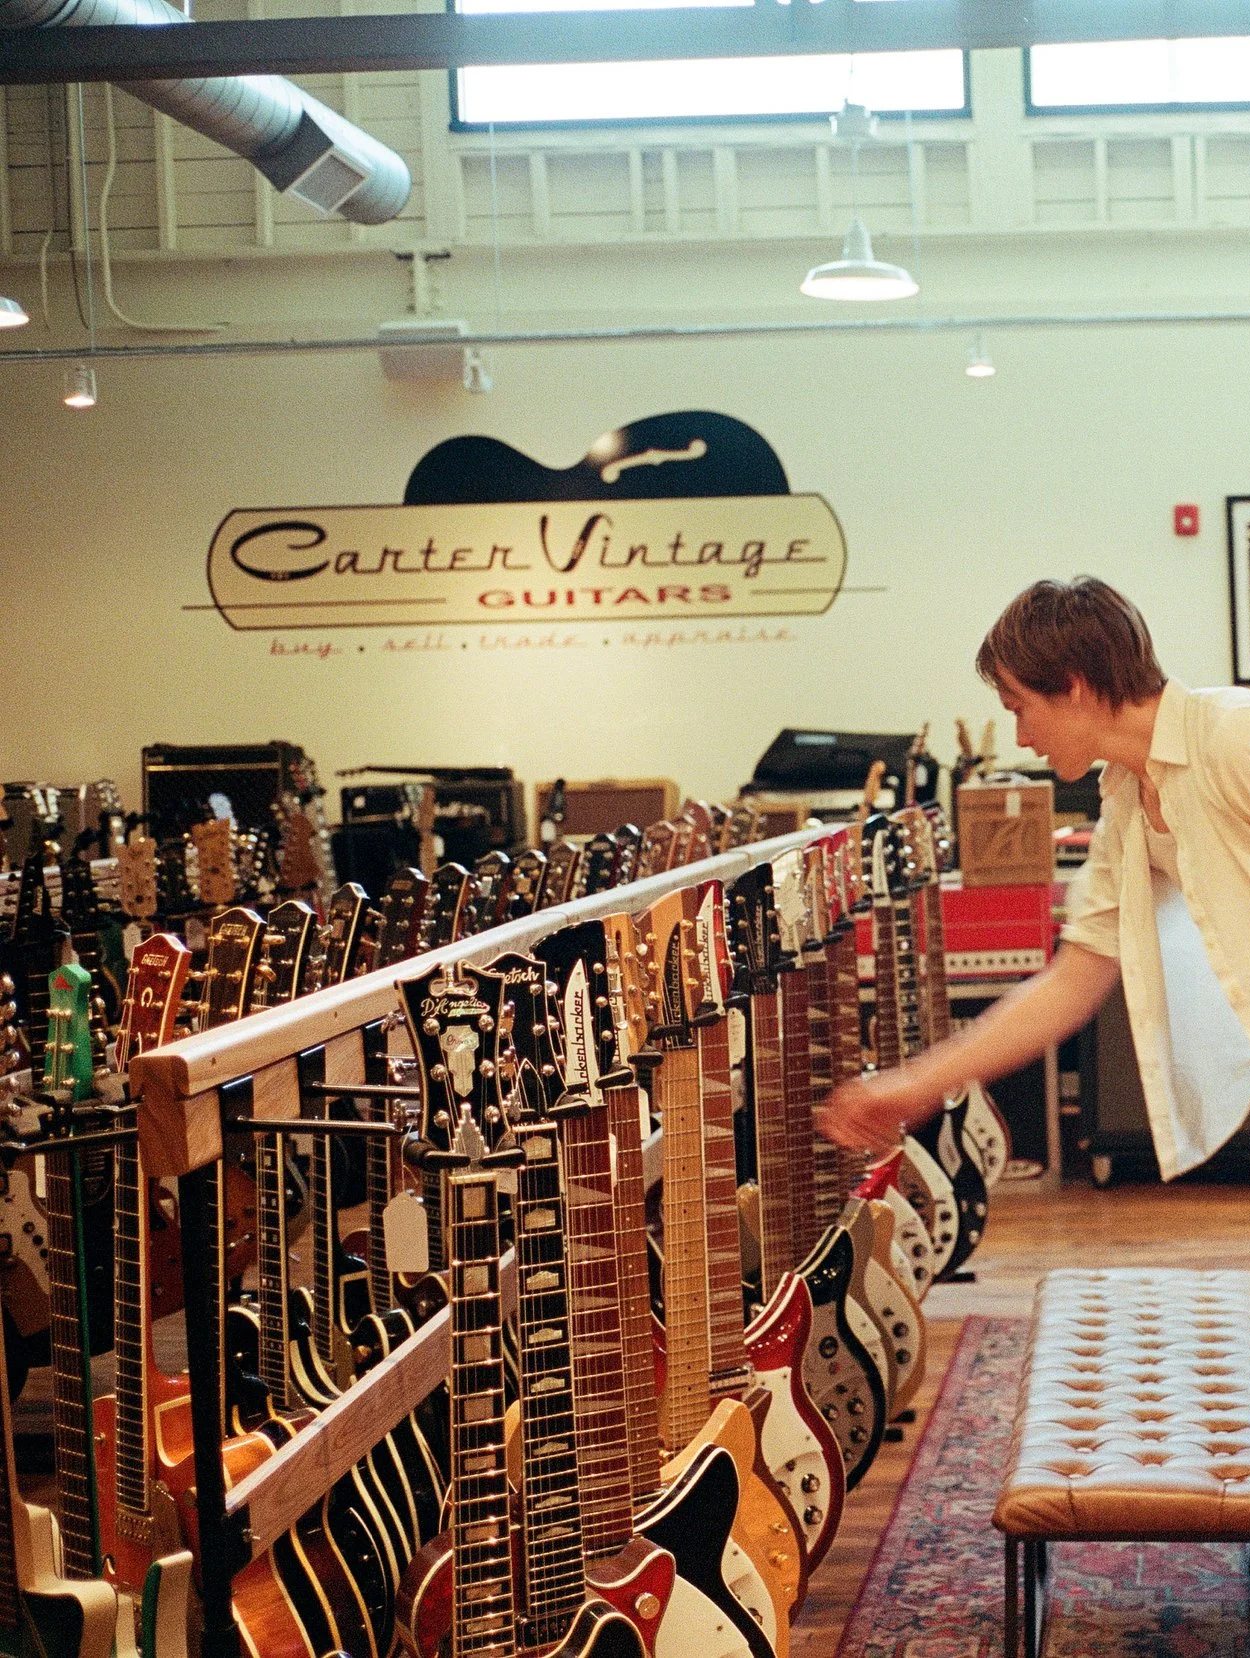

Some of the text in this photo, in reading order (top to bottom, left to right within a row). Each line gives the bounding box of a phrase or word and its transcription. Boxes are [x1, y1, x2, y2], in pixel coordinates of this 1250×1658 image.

[229, 512, 826, 582] Carter Vintage
[478, 583, 731, 609] GUITARS
[270, 637, 340, 659] buy
